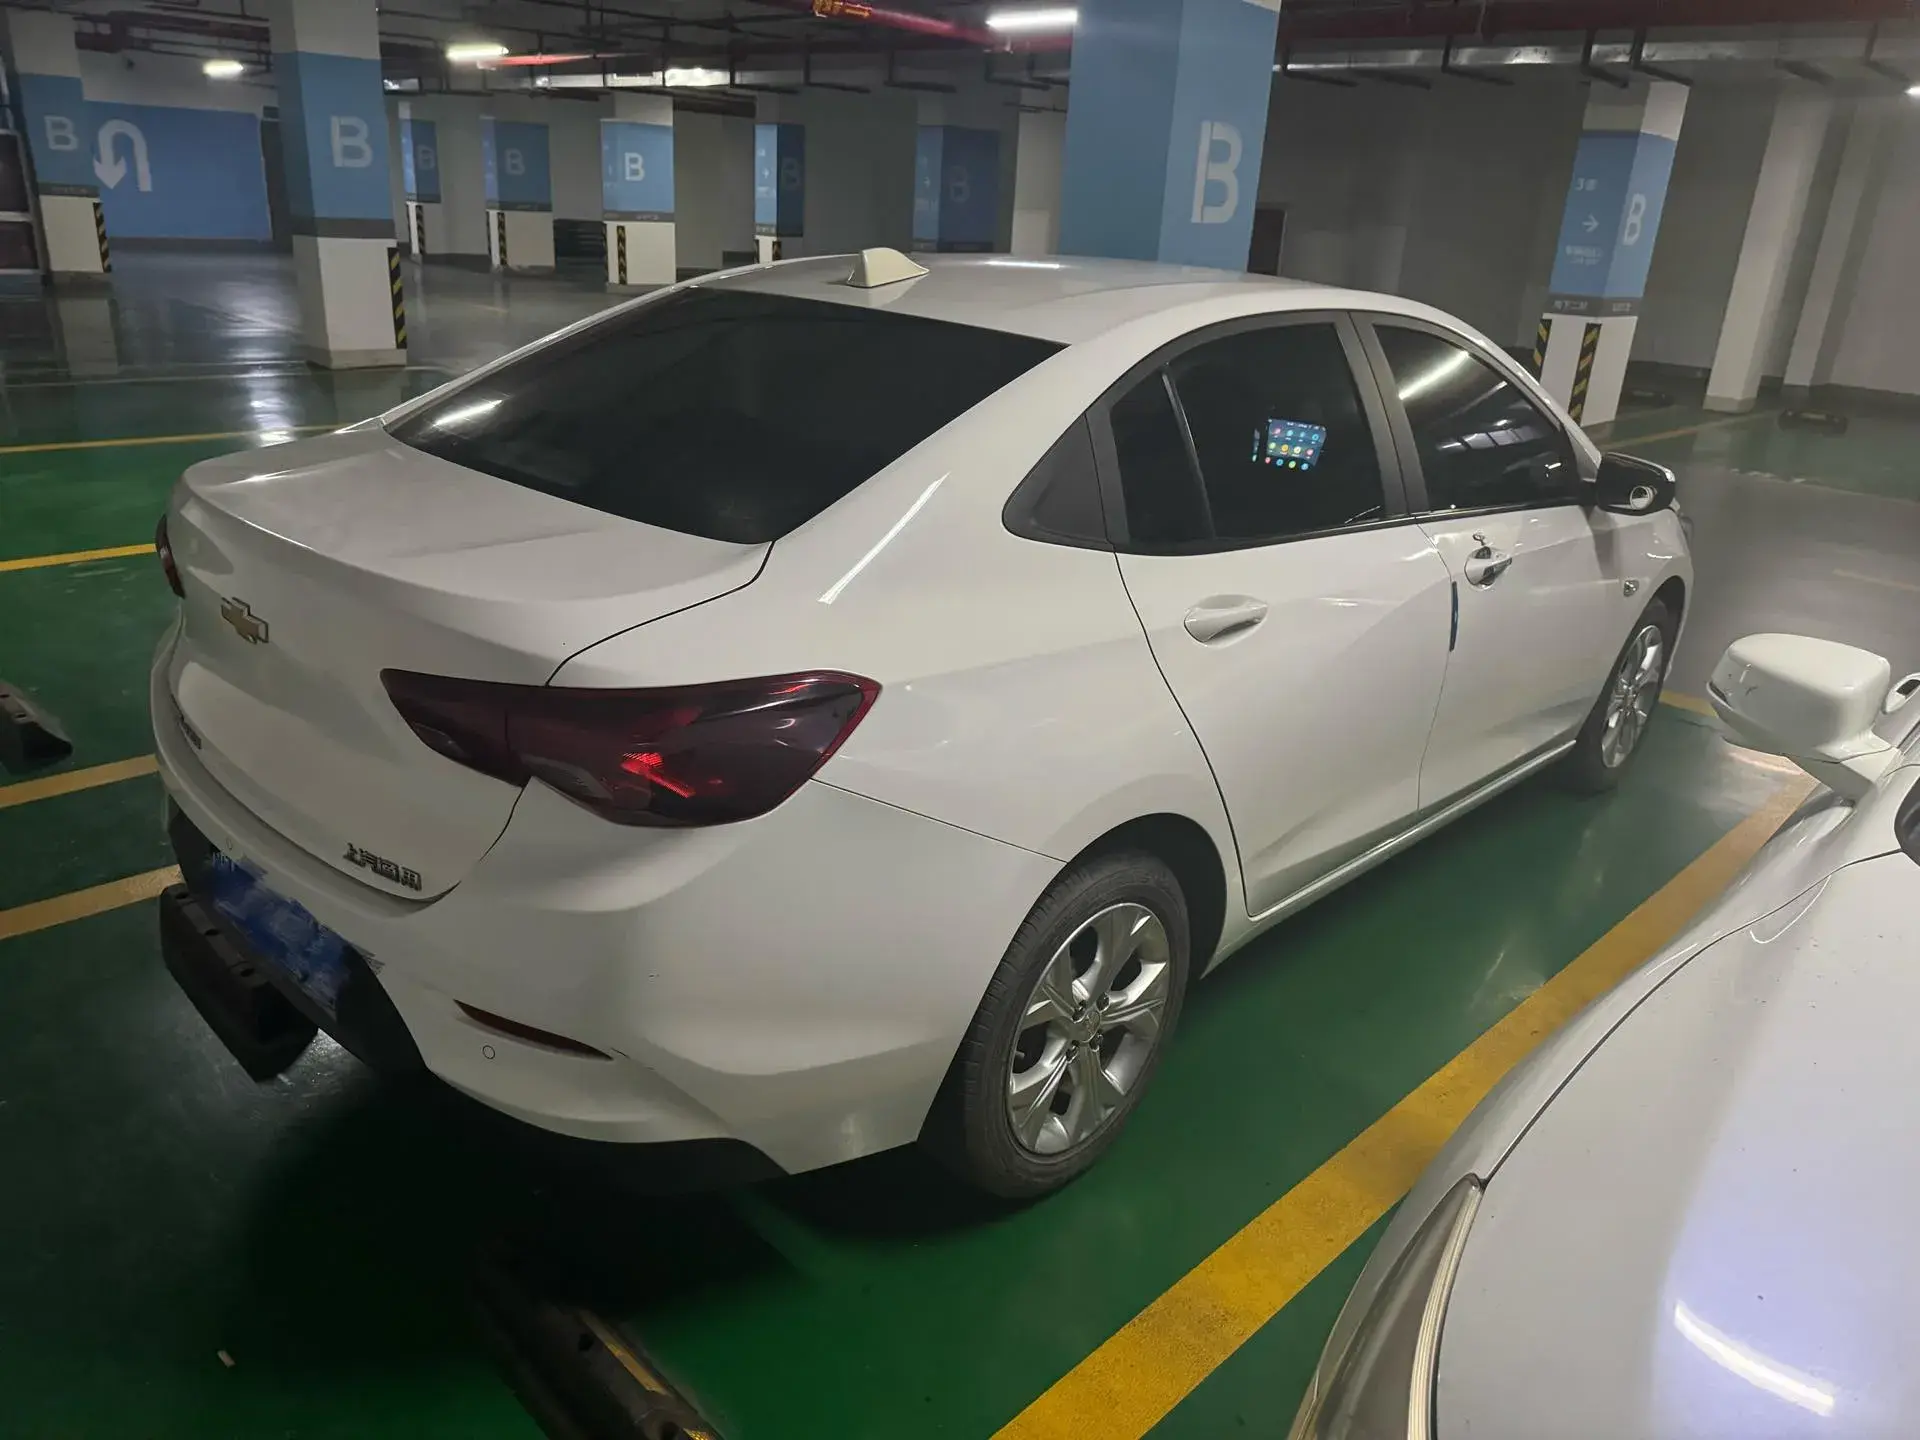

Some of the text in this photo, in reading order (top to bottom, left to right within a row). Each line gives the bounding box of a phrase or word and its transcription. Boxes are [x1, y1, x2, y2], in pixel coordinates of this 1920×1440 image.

[43, 116, 78, 150] B
[331, 115, 373, 167] B
[505, 148, 526, 176] B
[624, 152, 645, 181] B
[1191, 121, 1242, 223] B
[1622, 193, 1647, 246] B
